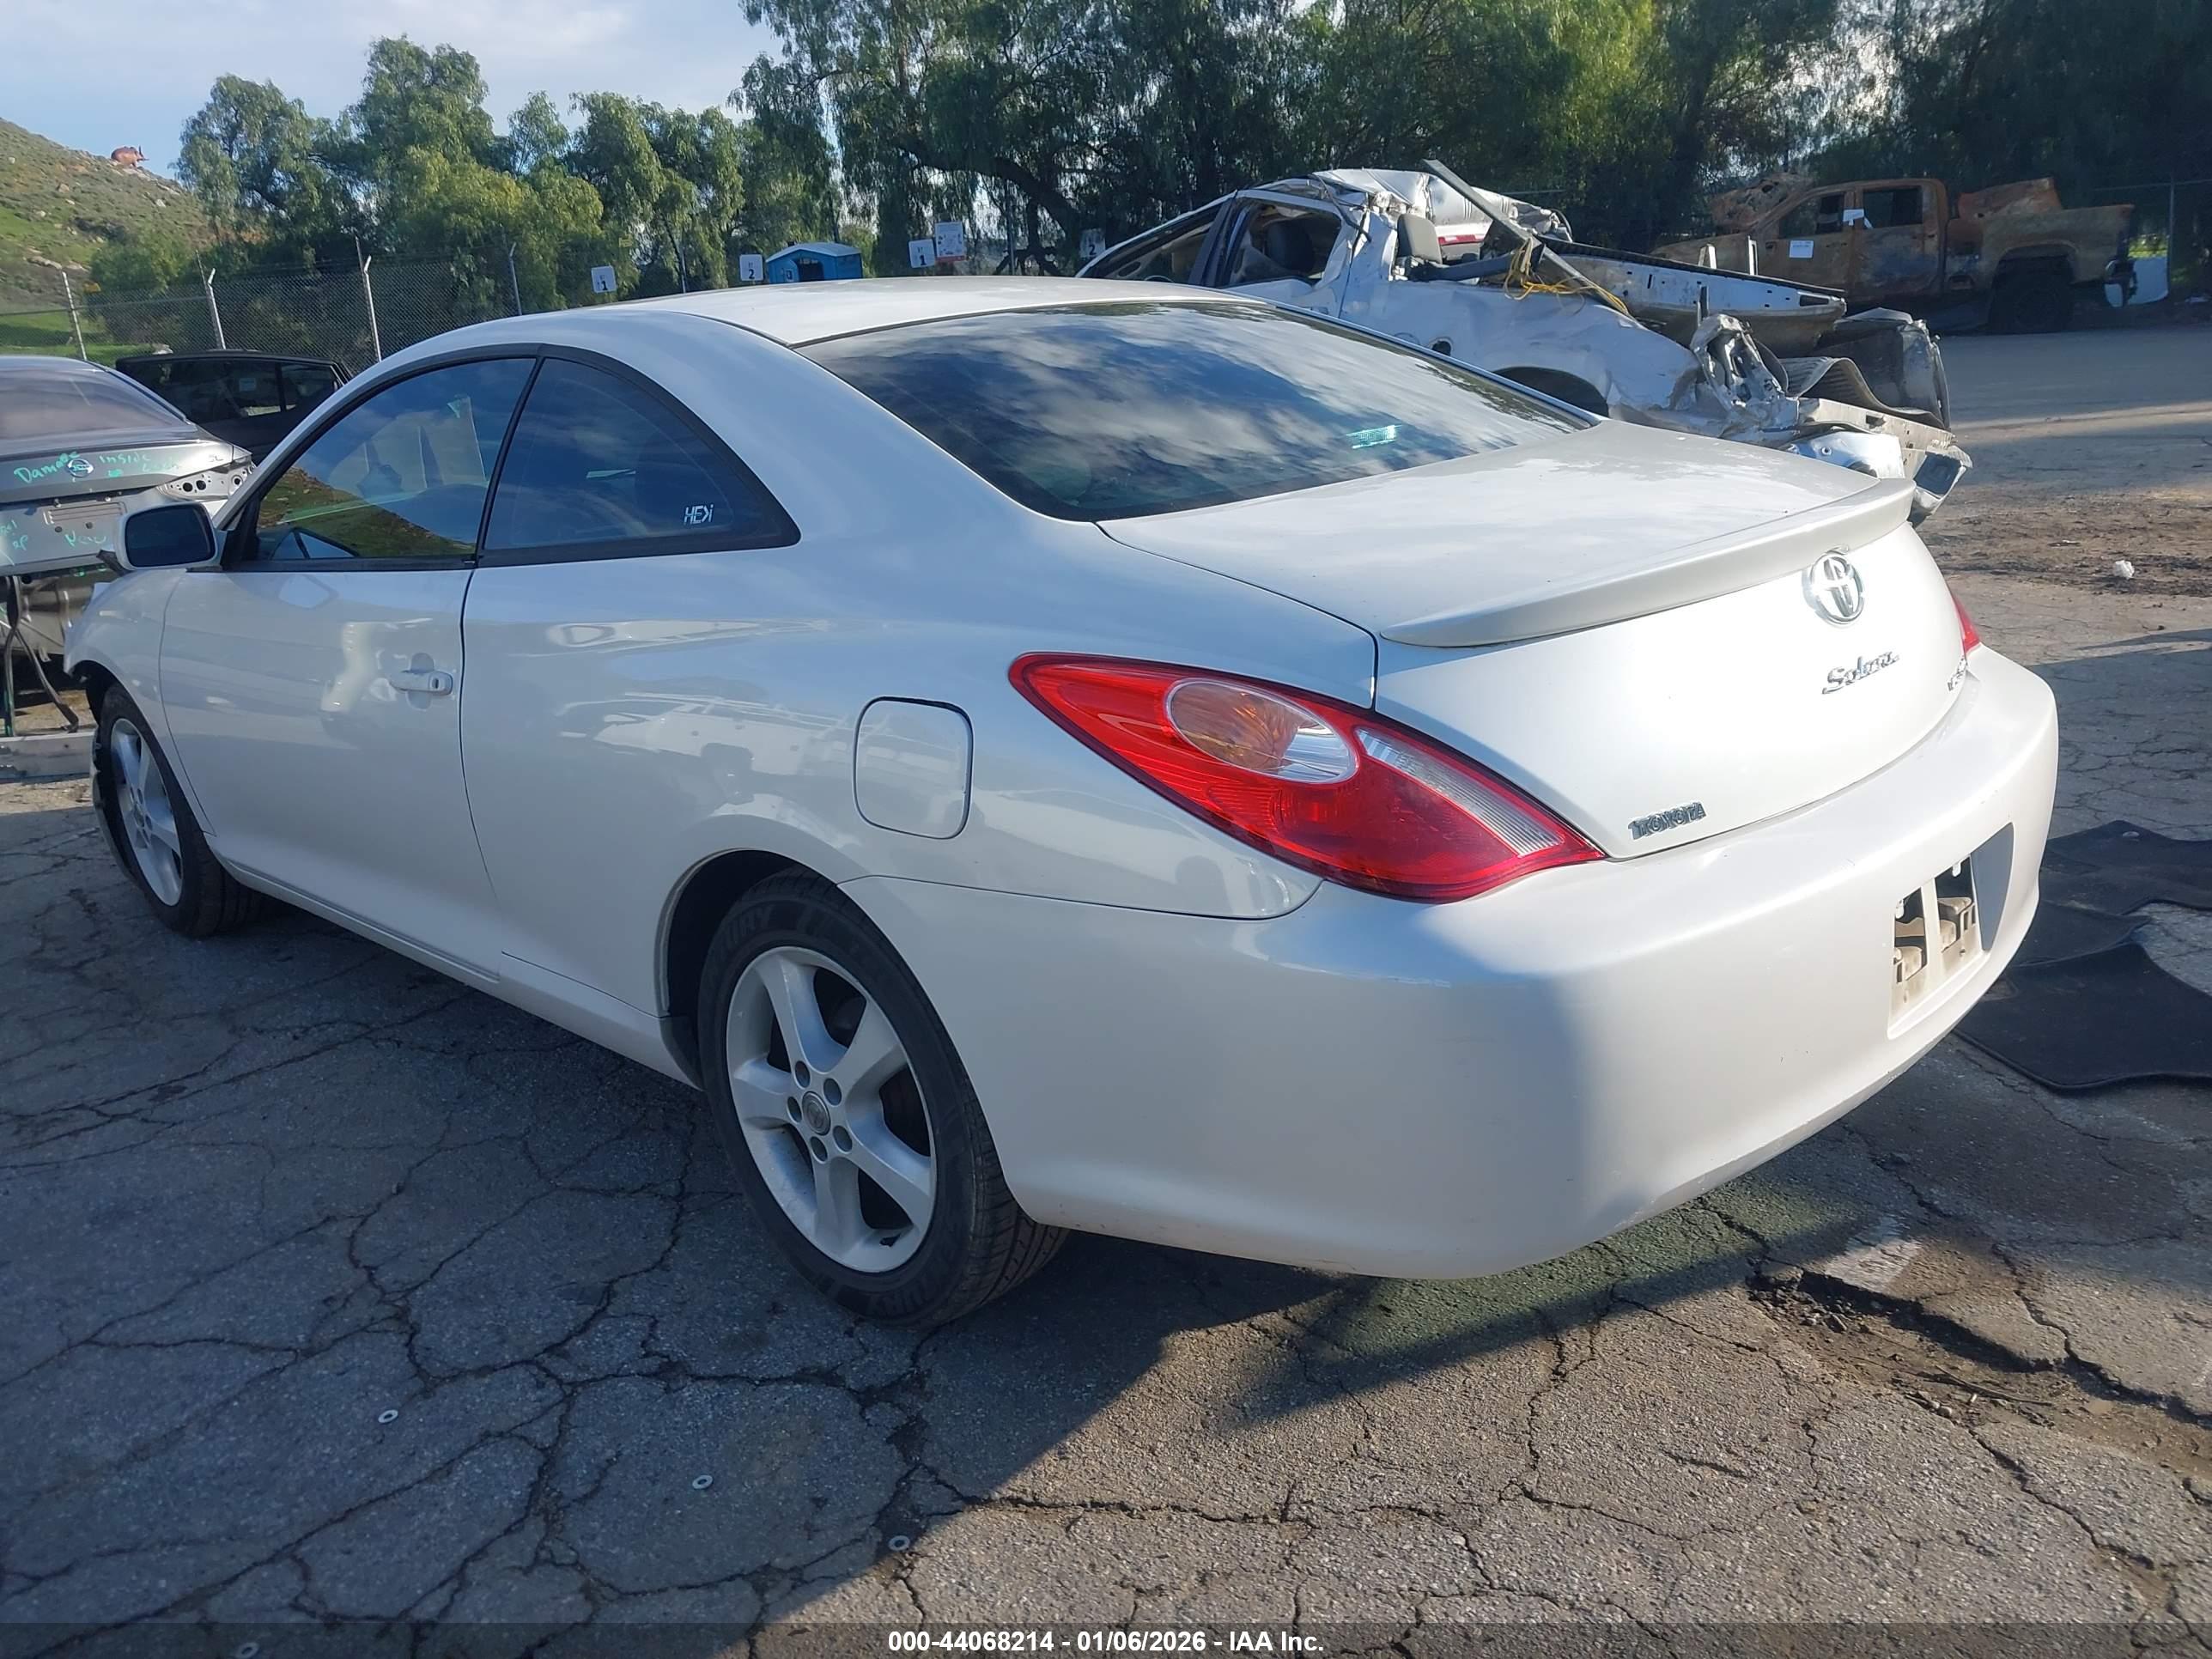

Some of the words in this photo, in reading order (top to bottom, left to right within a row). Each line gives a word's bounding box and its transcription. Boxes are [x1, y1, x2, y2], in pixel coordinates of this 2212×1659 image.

[919, 254, 927, 265] 1
[748, 269, 755, 279] 2
[601, 280, 608, 291] 1
[1821, 651, 1899, 695] Solara
[1627, 801, 1707, 840] TOYOTA
